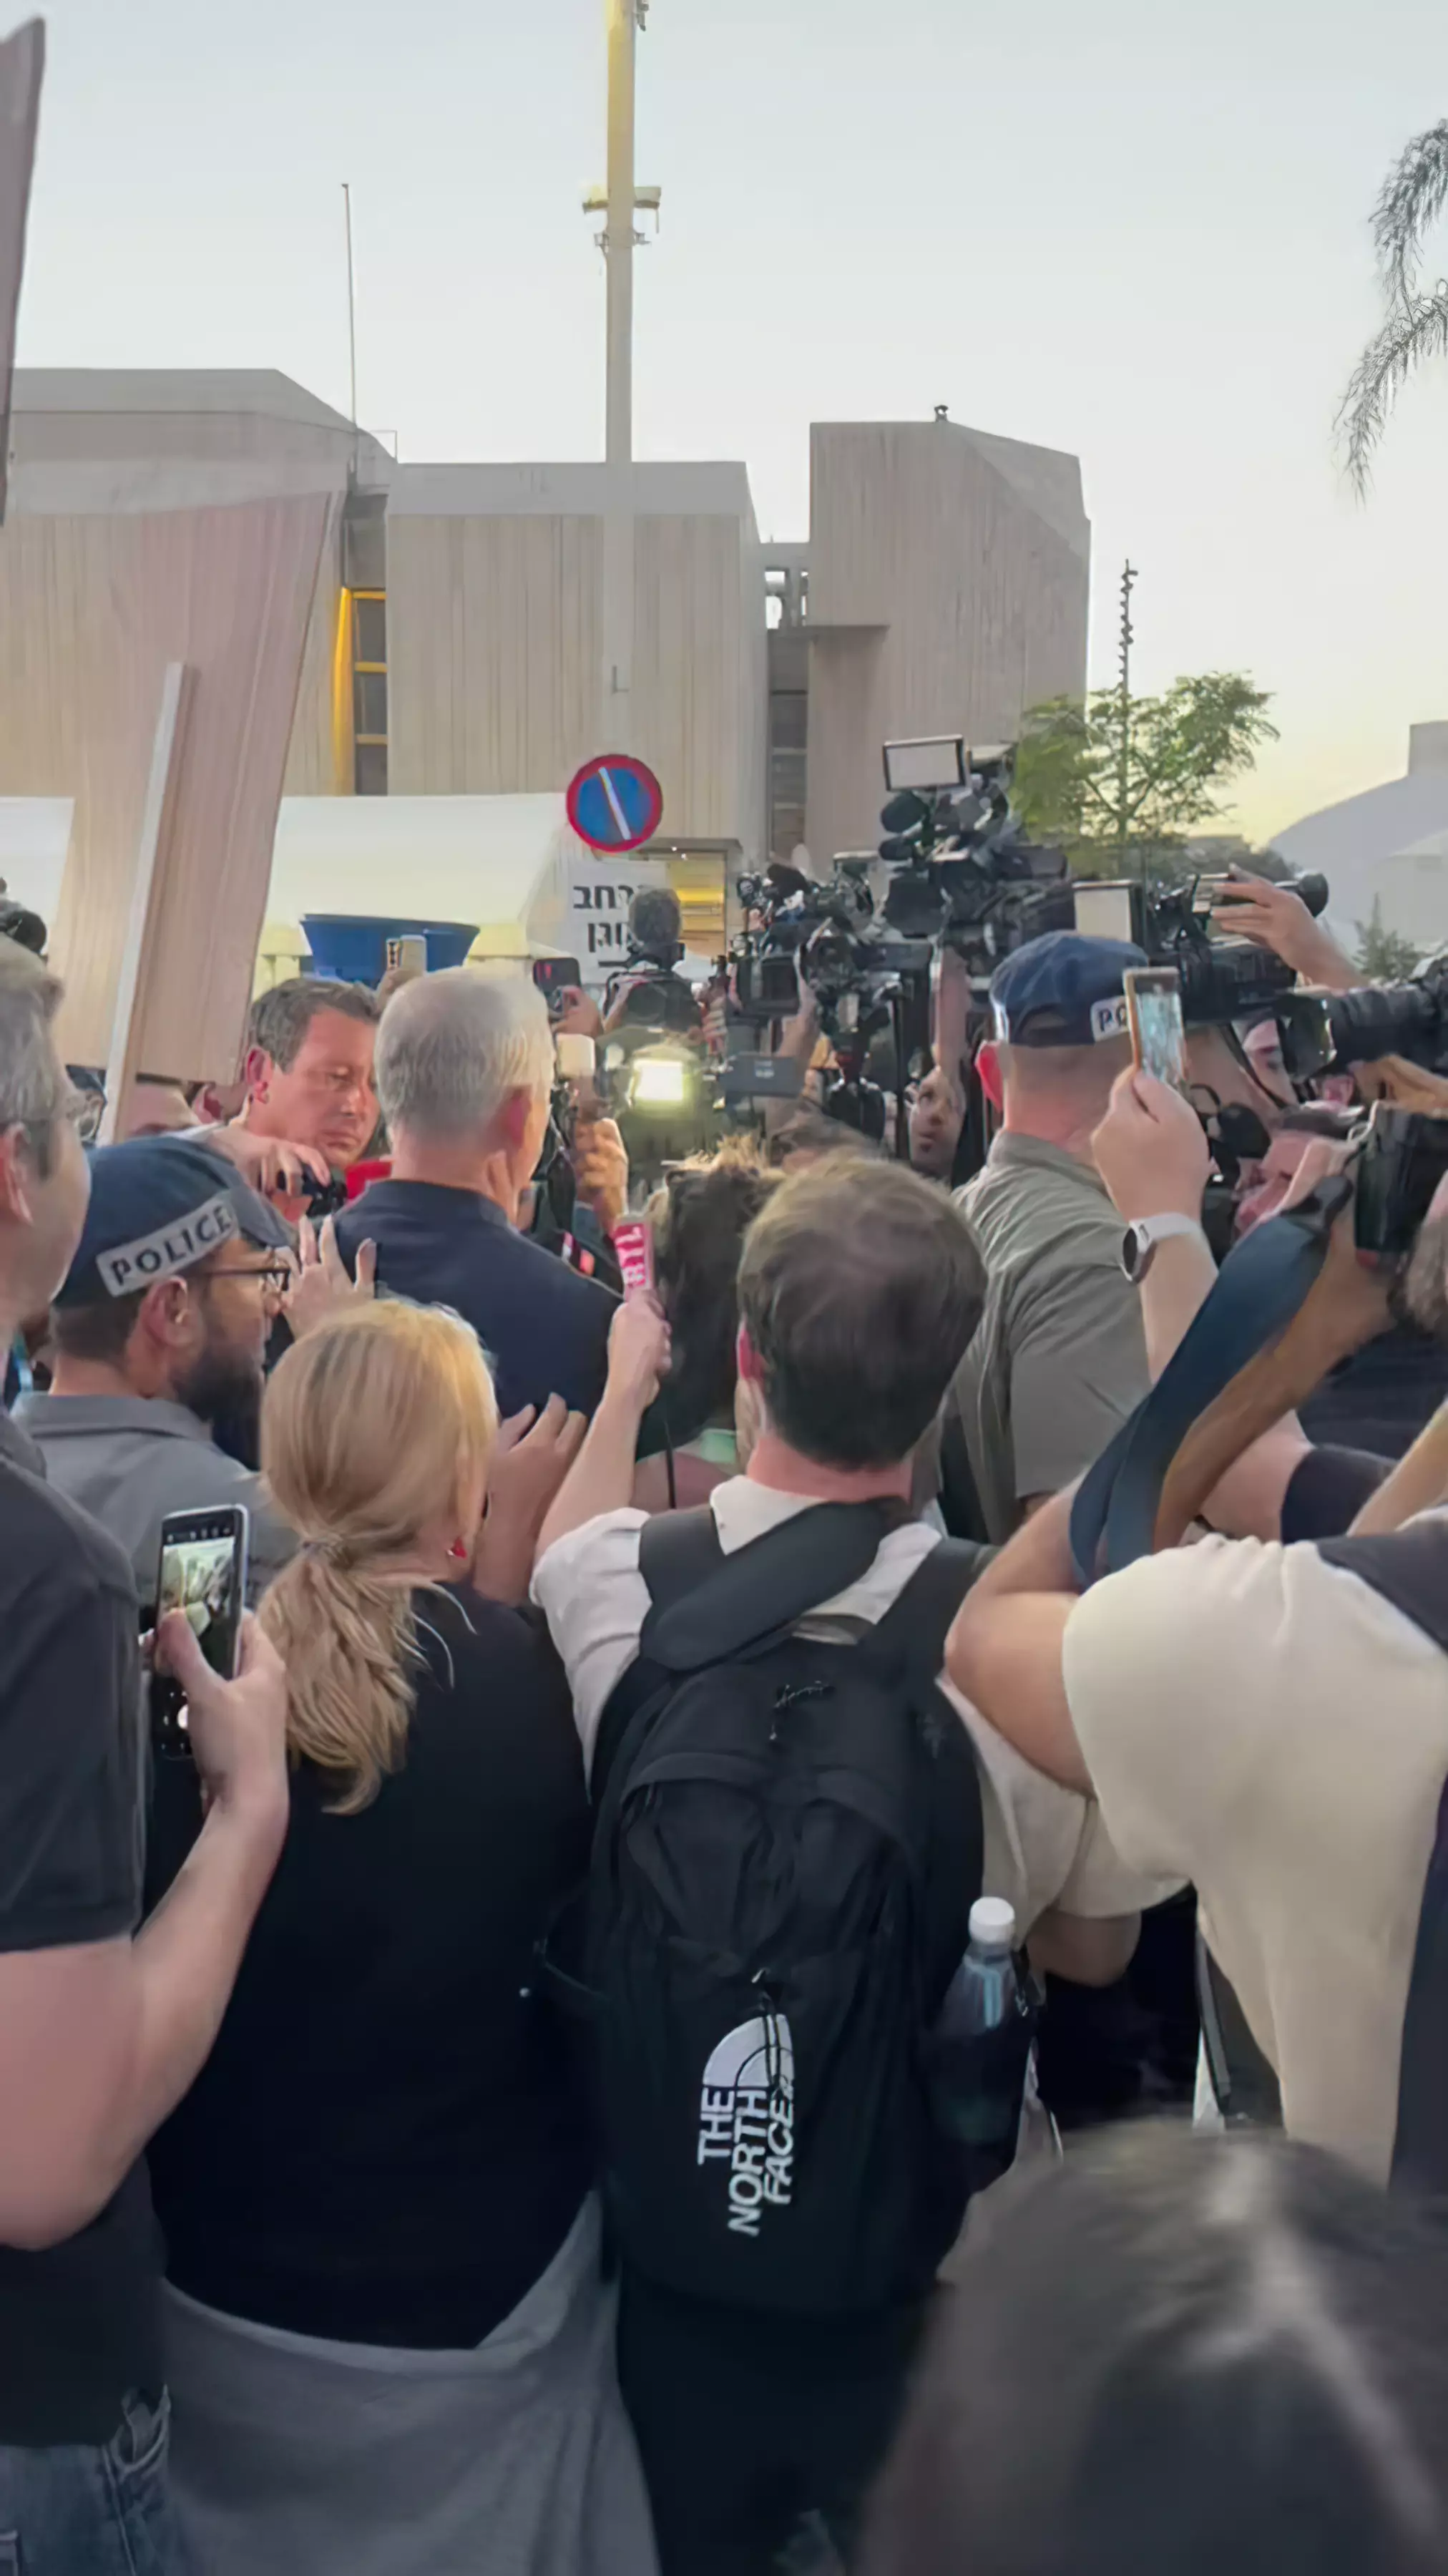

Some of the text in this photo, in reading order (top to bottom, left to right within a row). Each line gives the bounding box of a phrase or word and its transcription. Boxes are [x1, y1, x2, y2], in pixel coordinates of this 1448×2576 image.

[573, 885, 644, 909] רחב
[111, 1205, 233, 1287] POLICE
[615, 1226, 645, 1286] RTL
[698, 2087, 735, 2165] THE
[727, 2089, 768, 2237] NORTH
[763, 2099, 793, 2205] FACE
